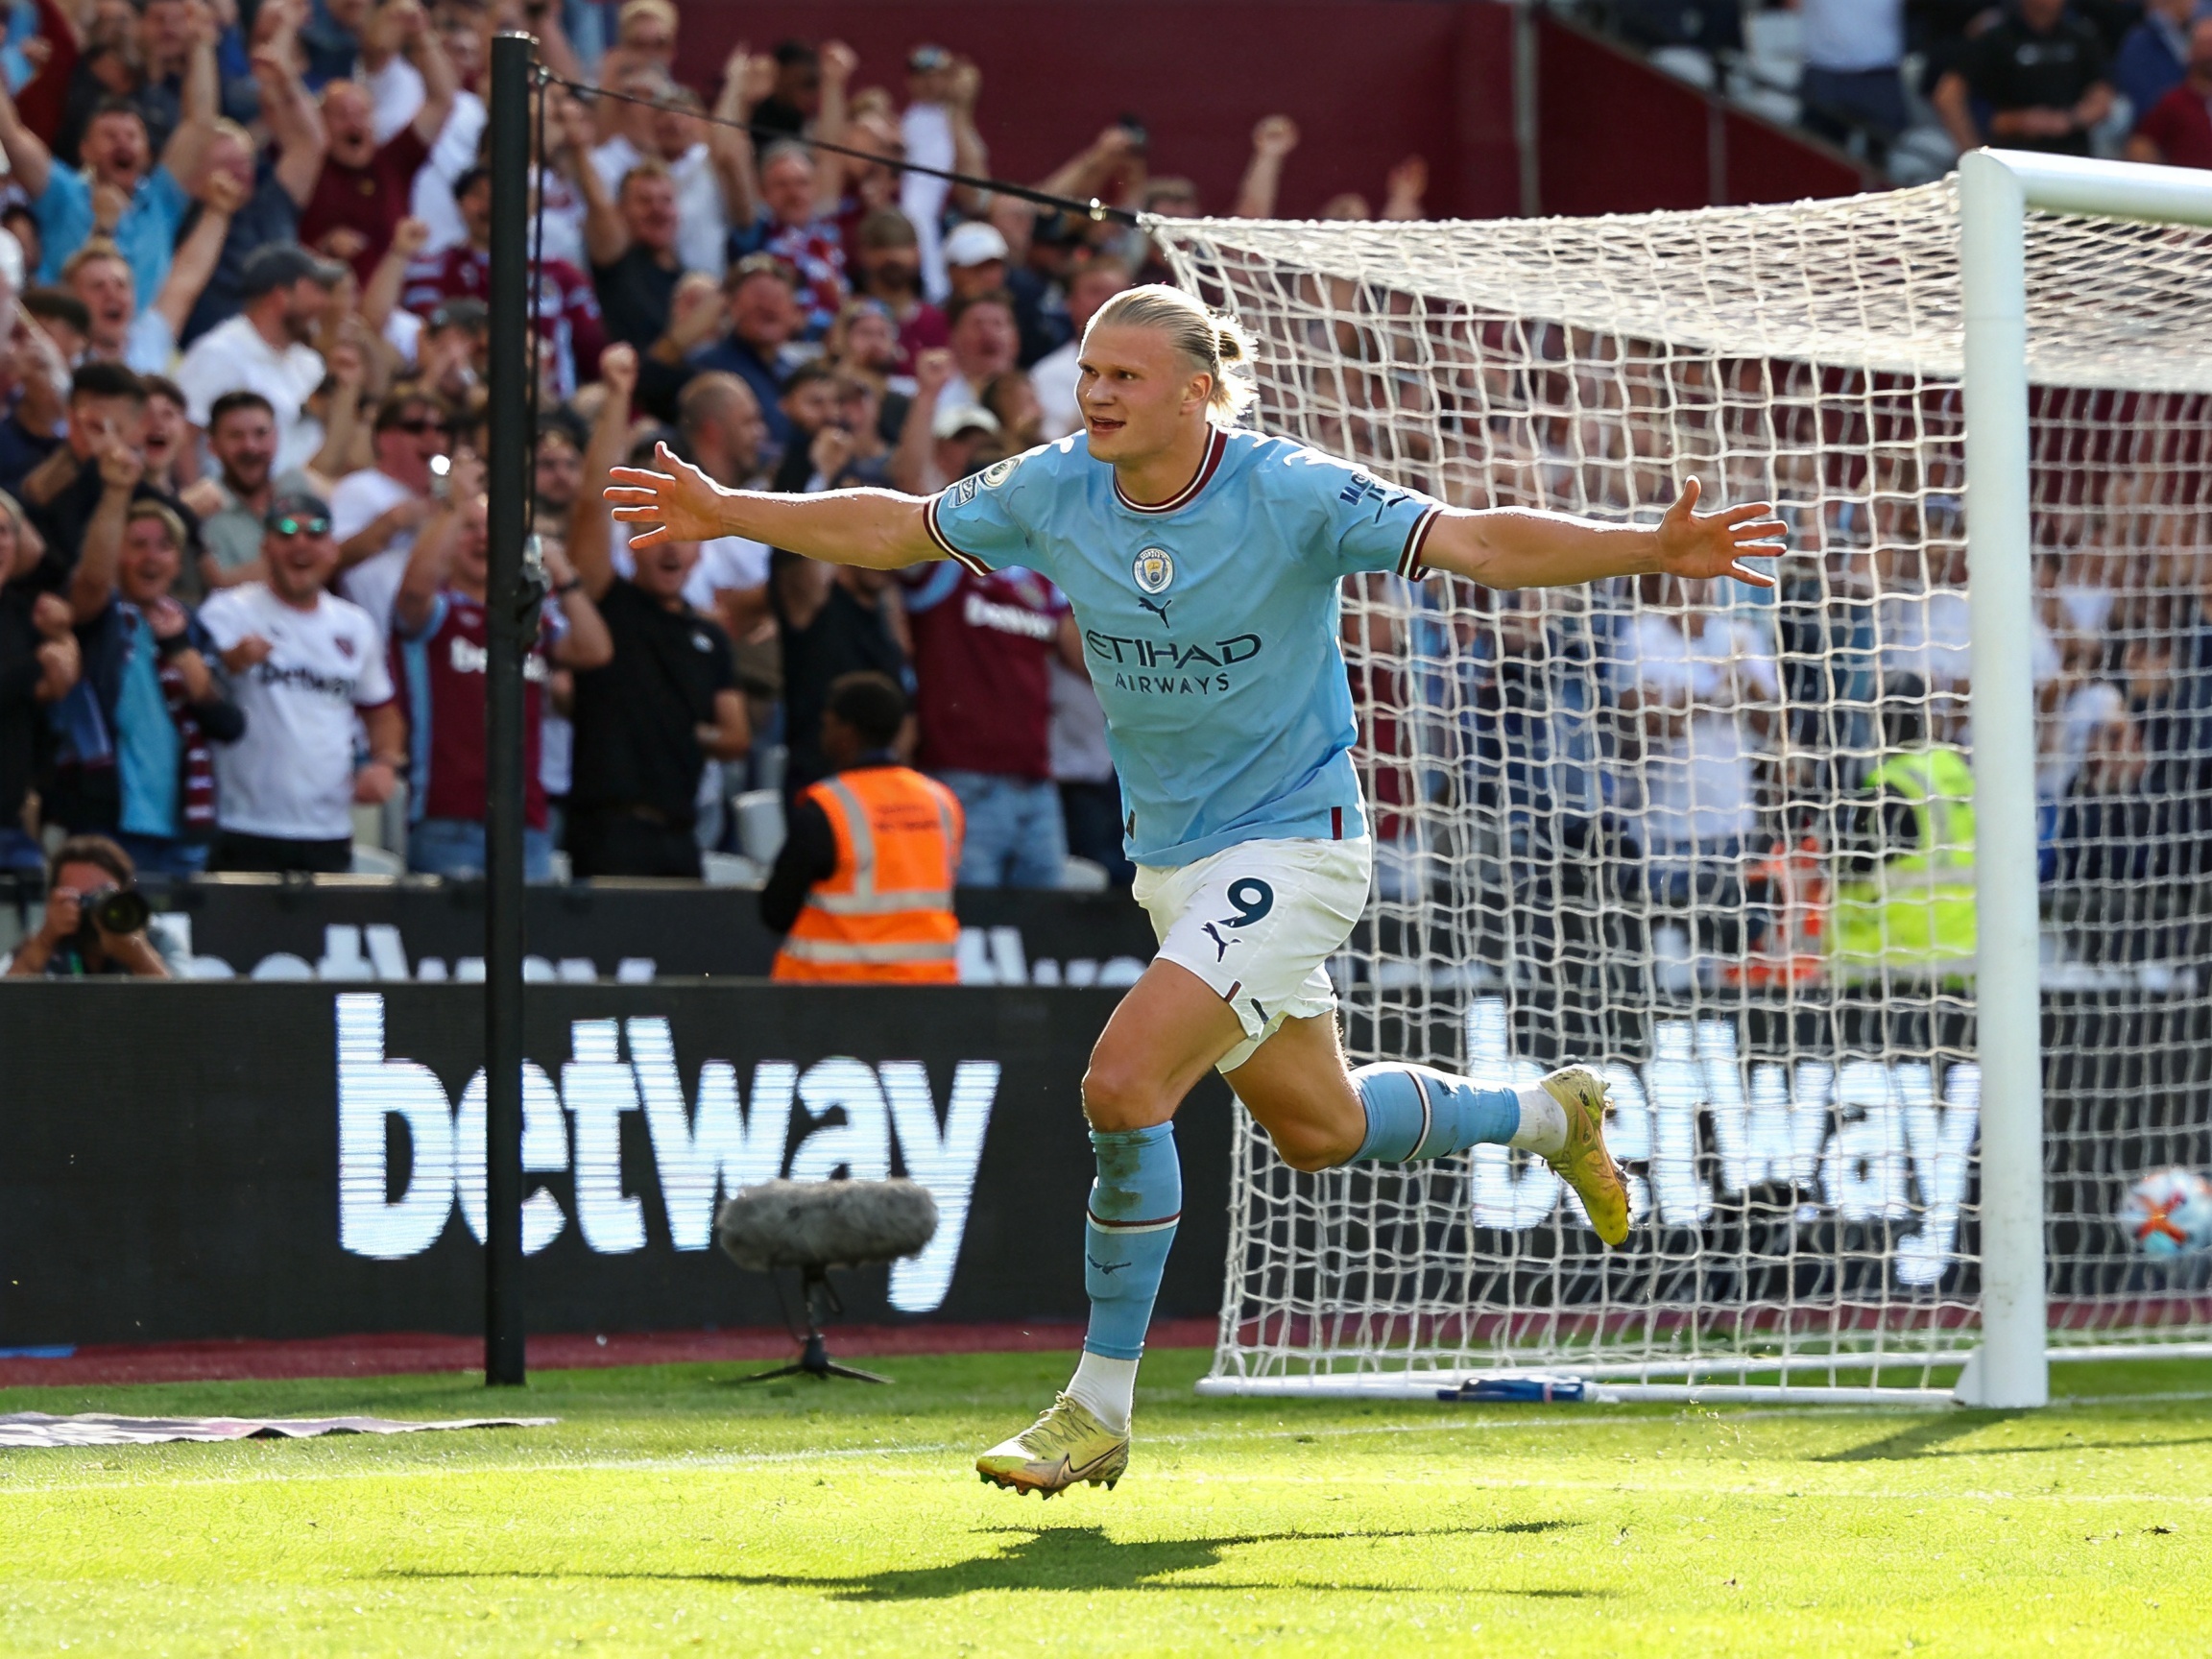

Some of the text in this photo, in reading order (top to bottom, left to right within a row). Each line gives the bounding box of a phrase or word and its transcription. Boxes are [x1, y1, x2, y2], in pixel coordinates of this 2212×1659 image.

[1086, 629, 1262, 669] ETIHAD
[1115, 672, 1230, 695] AIRWAYS
[1227, 877, 1274, 928] 9
[334, 992, 1001, 1312] betway
